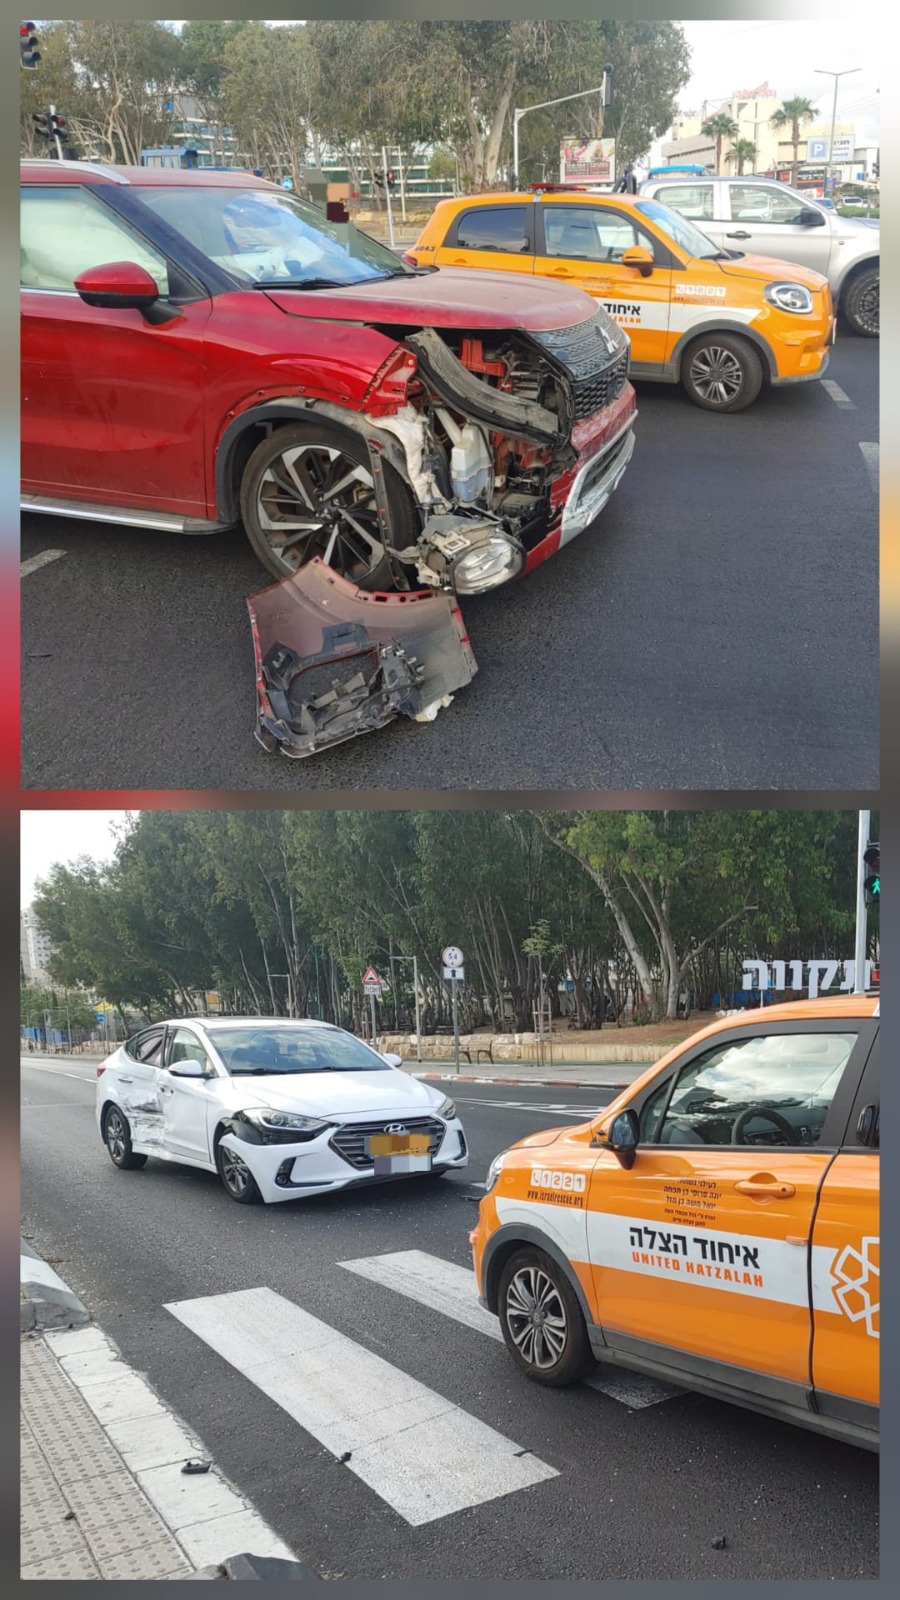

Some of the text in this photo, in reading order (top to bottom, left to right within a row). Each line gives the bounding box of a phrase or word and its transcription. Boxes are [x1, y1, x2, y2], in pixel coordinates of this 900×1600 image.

[603, 303, 641, 316] איחוד
[742, 959, 871, 999] תקווה
[543, 1173, 583, 1189] 1221
[629, 1226, 761, 1270] איחוד הצלה
[632, 1251, 764, 1288] UNITED HATZALAH
